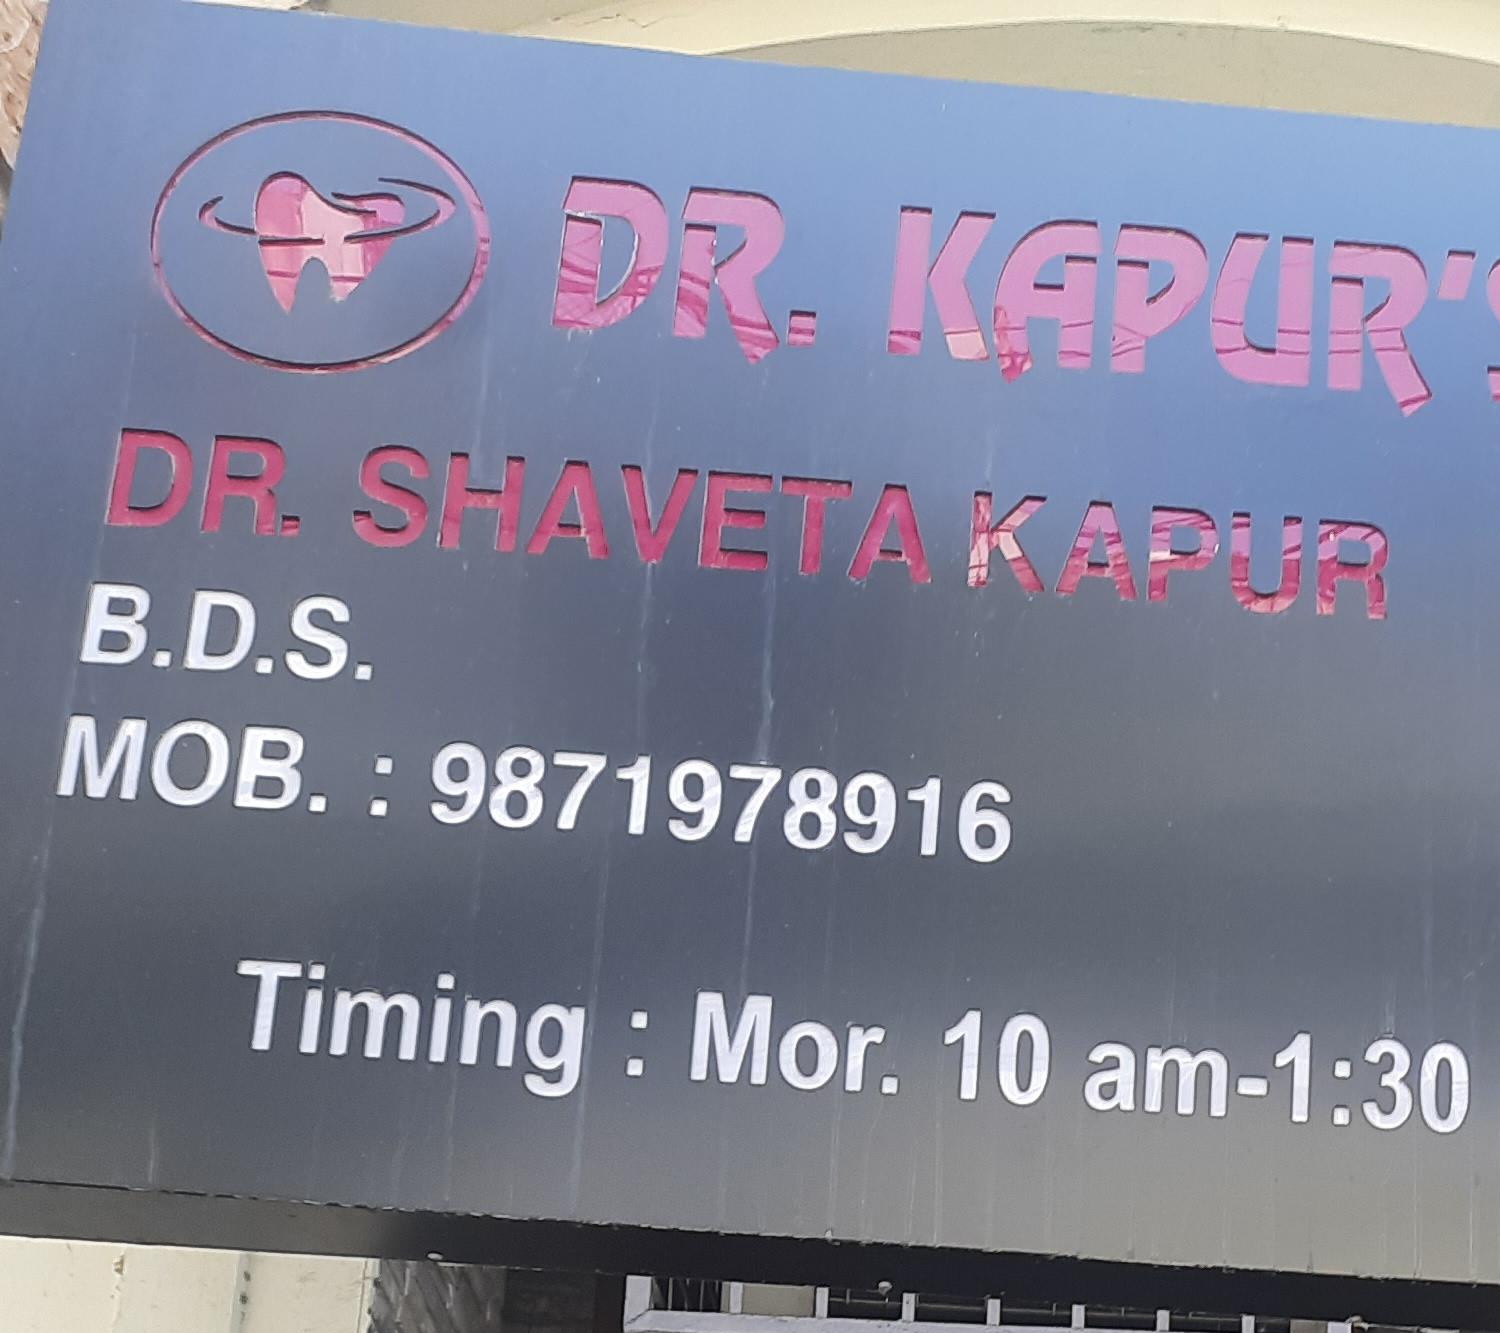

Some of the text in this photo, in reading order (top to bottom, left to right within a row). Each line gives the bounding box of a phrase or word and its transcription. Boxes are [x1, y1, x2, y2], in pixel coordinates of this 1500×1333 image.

[552, 174, 818, 364] DR.
[103, 426, 1390, 621] DR. SHAVETA KAPUR
[79, 581, 374, 682] B.D.S.
[56, 713, 327, 814] MOB.
[429, 741, 1014, 864] 9871978916
[236, 957, 586, 1099] Timing
[688, 989, 901, 1095] Mor.
[943, 1008, 1051, 1109] 10
[1082, 1030, 1471, 1135] am-1:30
